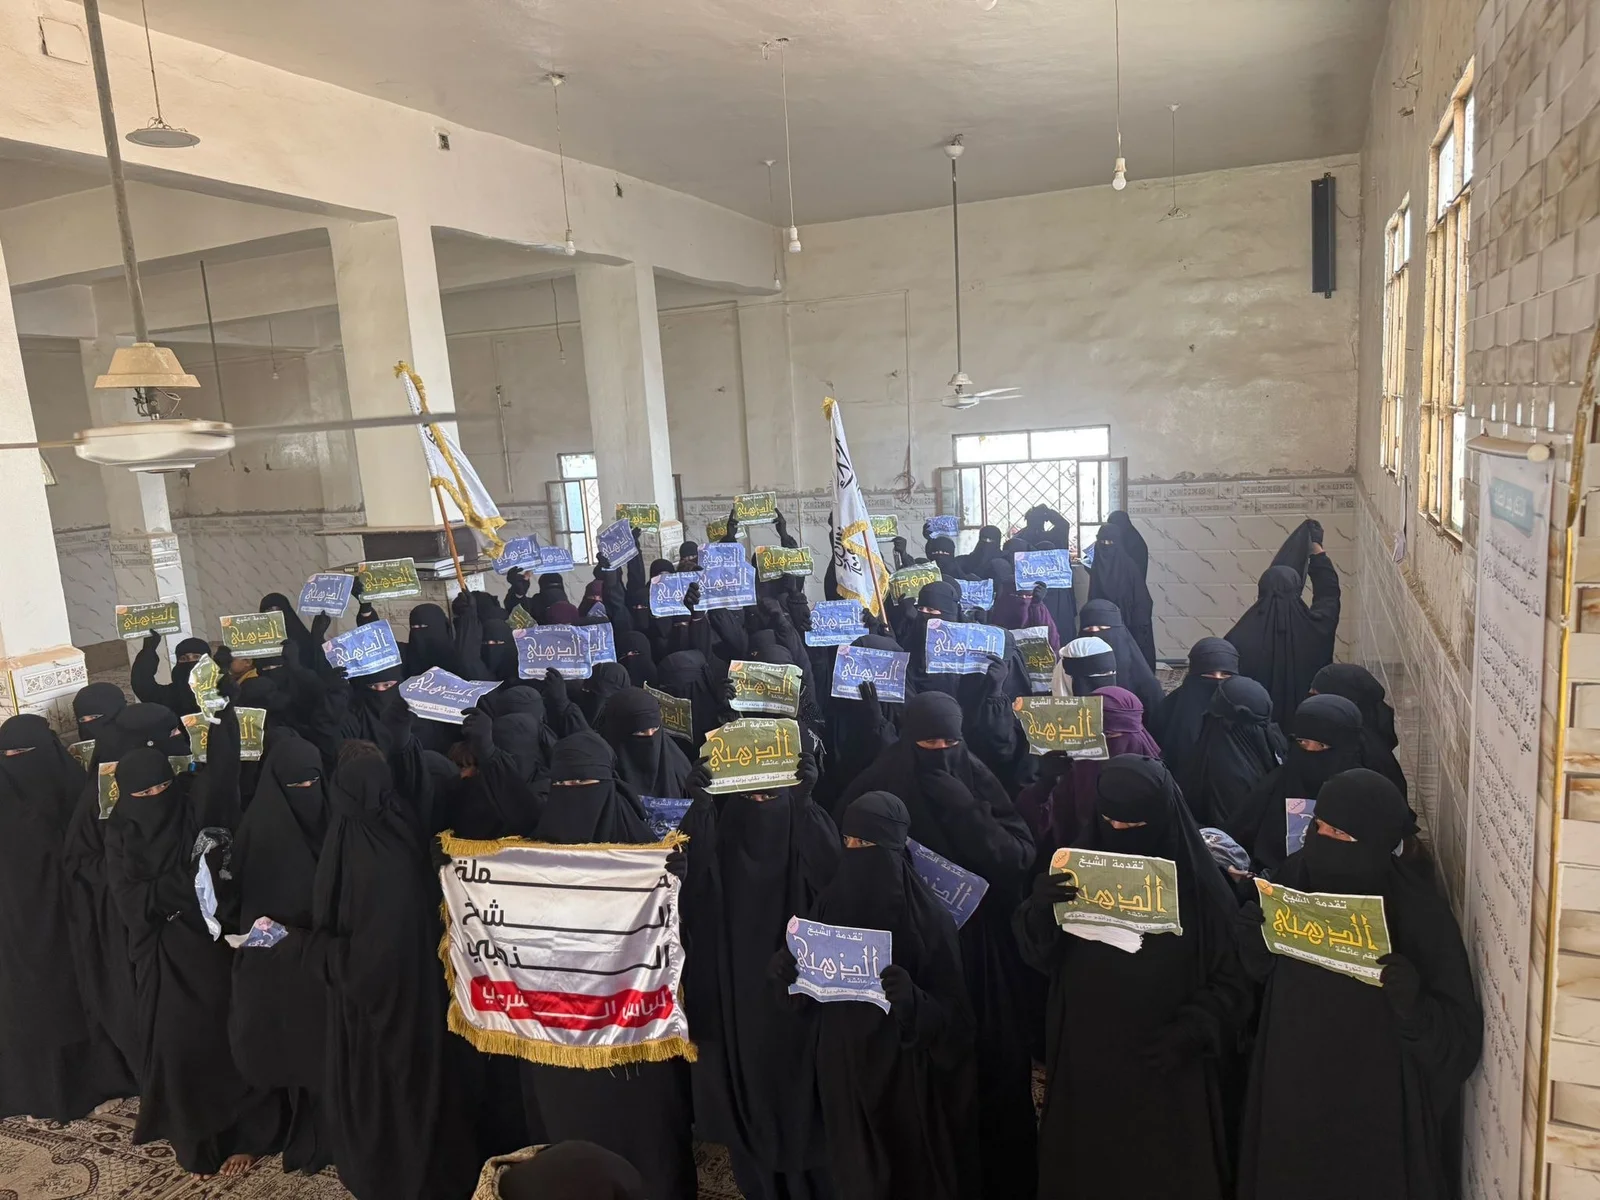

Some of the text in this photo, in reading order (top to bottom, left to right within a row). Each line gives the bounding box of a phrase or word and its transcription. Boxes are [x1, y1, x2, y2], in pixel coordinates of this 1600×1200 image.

[362, 565, 414, 591] الذهبي
[697, 567, 750, 595] الذهبي
[124, 607, 176, 630] الذهبي
[811, 606, 864, 632] الذهبي
[229, 620, 282, 648] الذهبي
[332, 628, 390, 666] الذهبي
[934, 629, 996, 656] الذهبي
[524, 634, 584, 663] الذهبي
[841, 655, 900, 682] الذهبي
[735, 672, 793, 696] الذهبي
[1030, 697, 1078, 708] تقدمة الشيخ
[723, 720, 745, 733] الشيخ
[1021, 708, 1096, 742] الذهبي
[709, 728, 793, 772] الذهبي
[455, 859, 671, 892] حملة
[941, 860, 967, 878] تقدمة
[1078, 856, 1107, 868] الشيخ
[1112, 858, 1144, 870] تقدمة
[1060, 868, 1167, 912] الذهبي
[1282, 892, 1347, 909] تقدمة الشيخ
[807, 925, 863, 941] تقدمة الشيخ
[1272, 897, 1380, 951] الذهبي
[467, 940, 669, 975] الذهبي
[793, 935, 881, 980] الذهبي
[1335, 945, 1359, 956] عائشة
[482, 986, 666, 1020] للباس الشرعي
